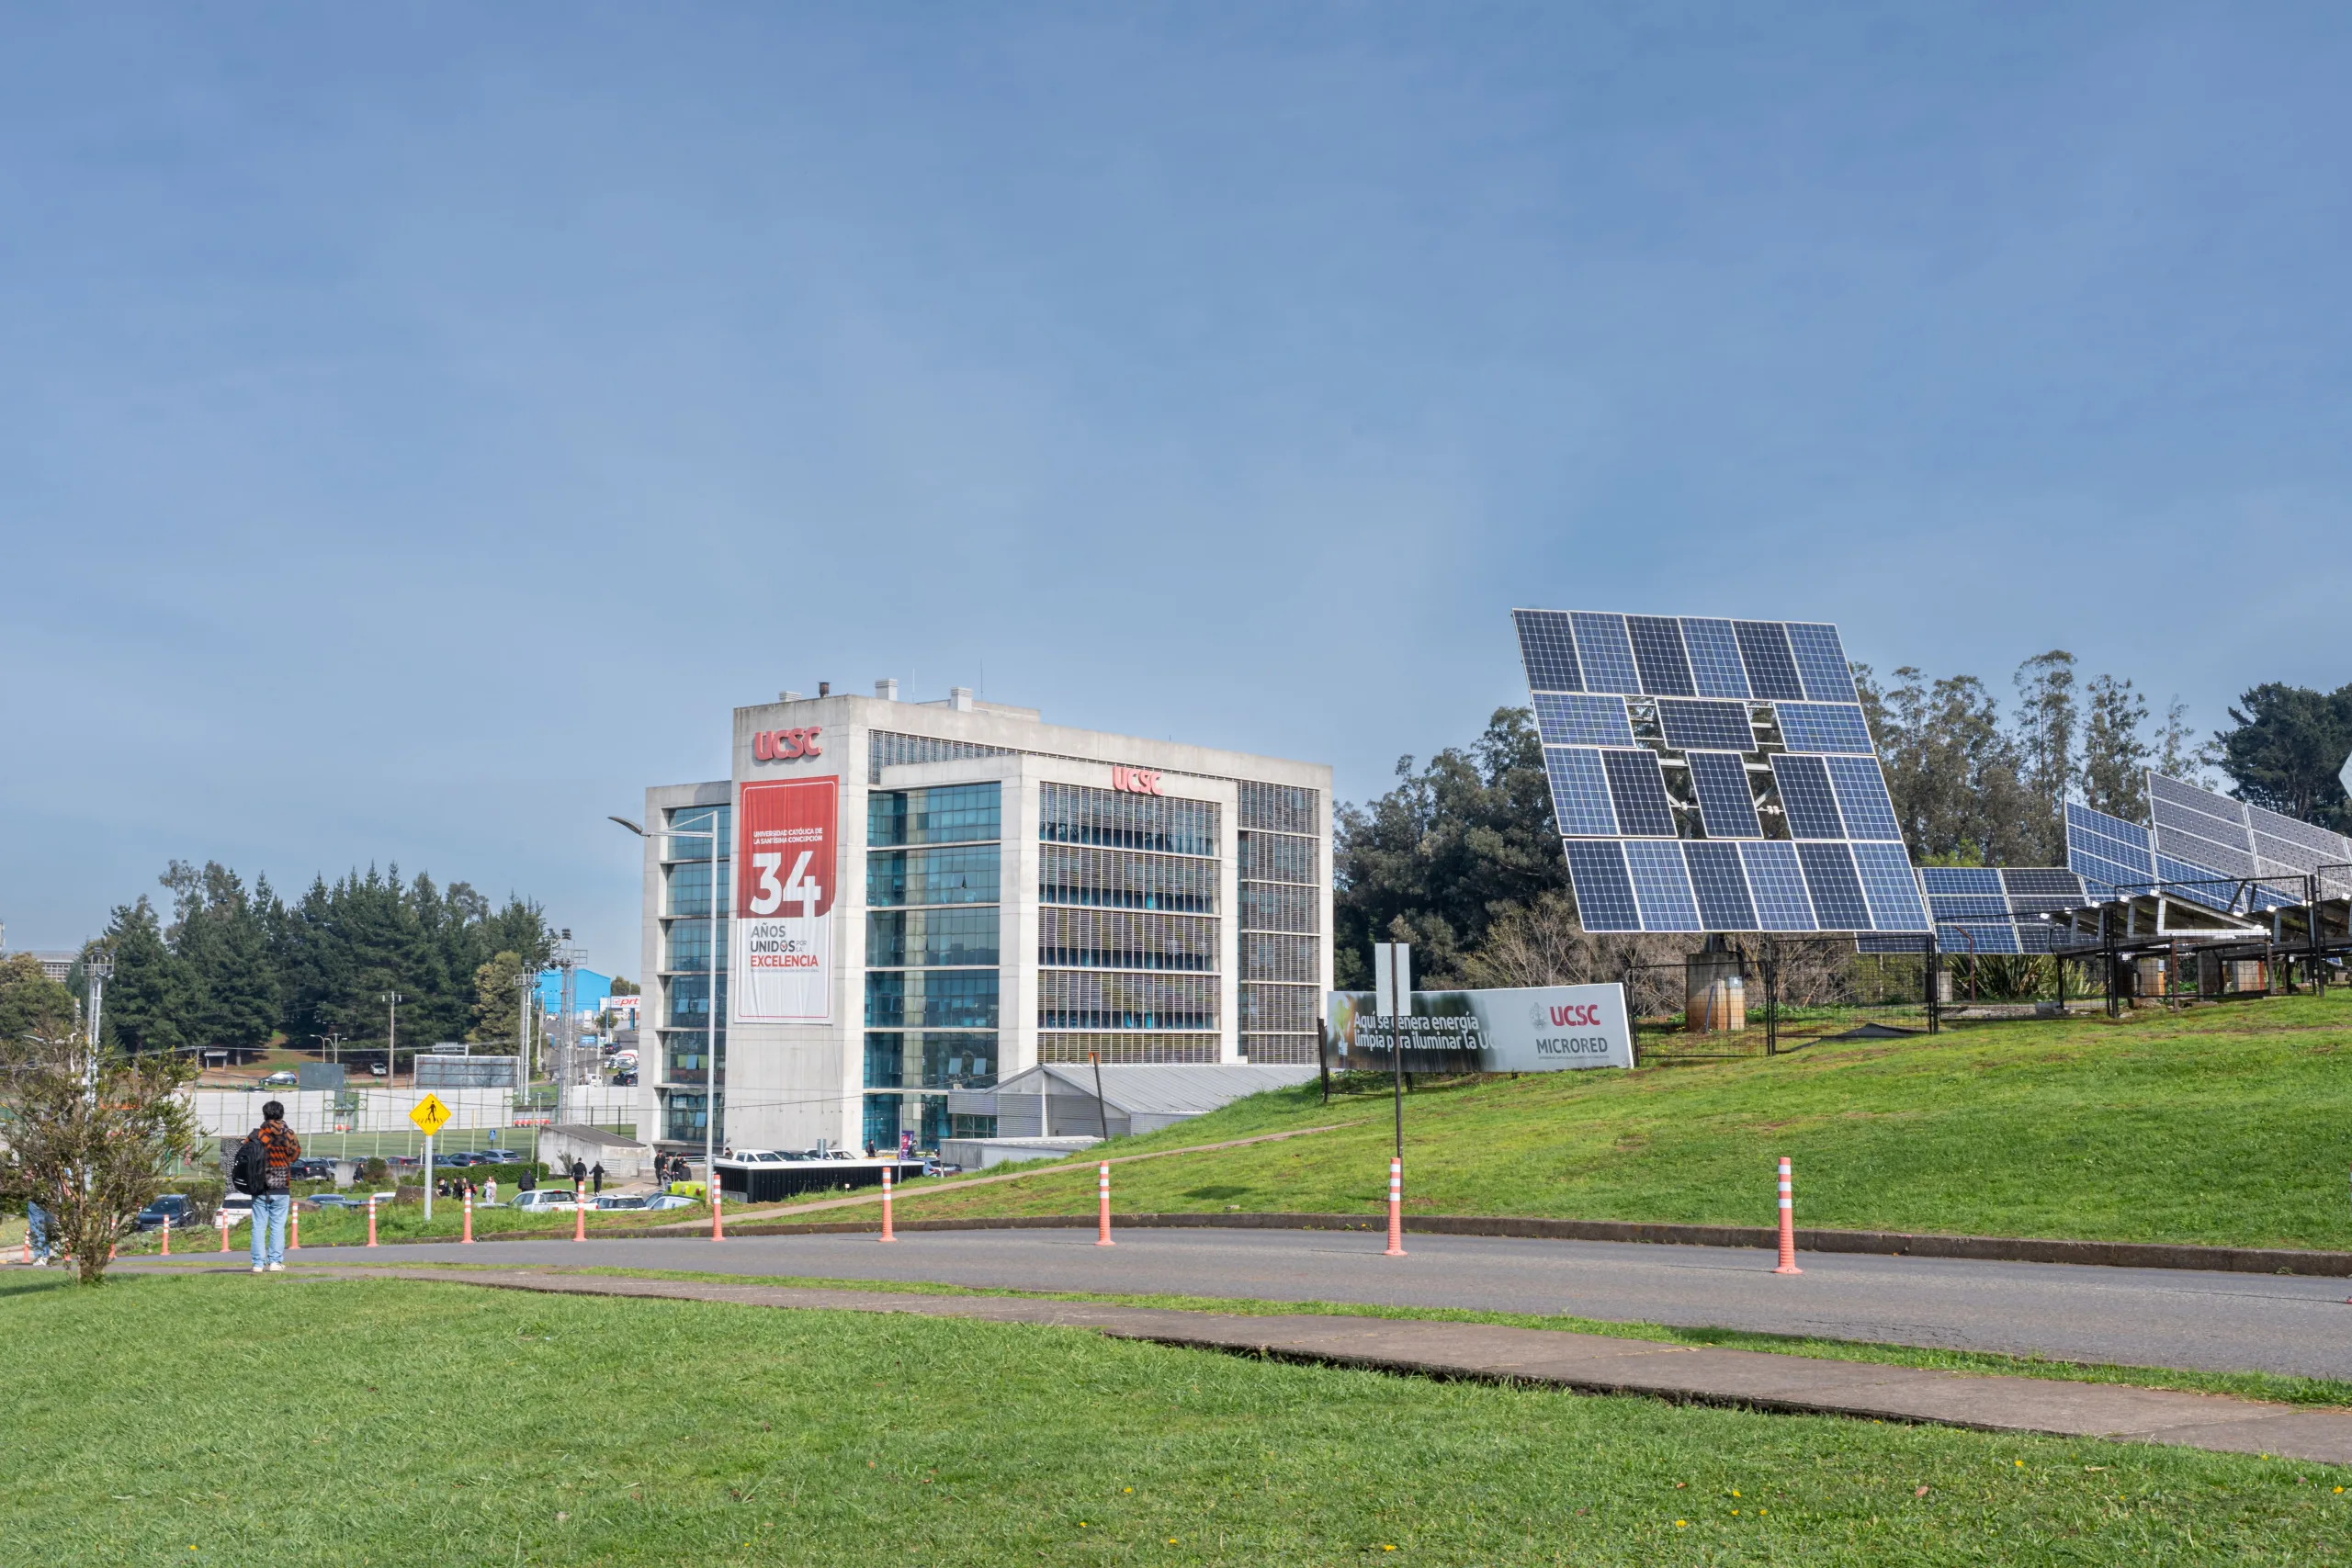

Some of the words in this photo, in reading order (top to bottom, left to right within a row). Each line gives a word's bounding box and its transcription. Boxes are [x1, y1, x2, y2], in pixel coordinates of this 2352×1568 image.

[755, 726, 822, 761] UCSC
[1113, 765, 1164, 796] UCSC
[753, 829, 787, 838] UNIVERSIDAD
[788, 827, 814, 836] CATÓLICA
[788, 834, 823, 843] CONCEPCIÓN
[750, 851, 821, 919] 34
[751, 922, 786, 938] AÑOS
[751, 940, 796, 953] UNIDOS
[751, 954, 819, 967] EXCELENCIA
[620, 998, 639, 1007] prt
[1353, 1010, 1376, 1032] Aquí
[1378, 1015, 1389, 1029] se
[1431, 1010, 1479, 1034] energía
[1550, 1004, 1600, 1026] UCSC
[1353, 1027, 1385, 1052] limpia
[1387, 1032, 1411, 1053] pra
[1412, 1030, 1462, 1050] iluminar
[1464, 1032, 1477, 1050] la
[1536, 1037, 1608, 1055] MICRORED
